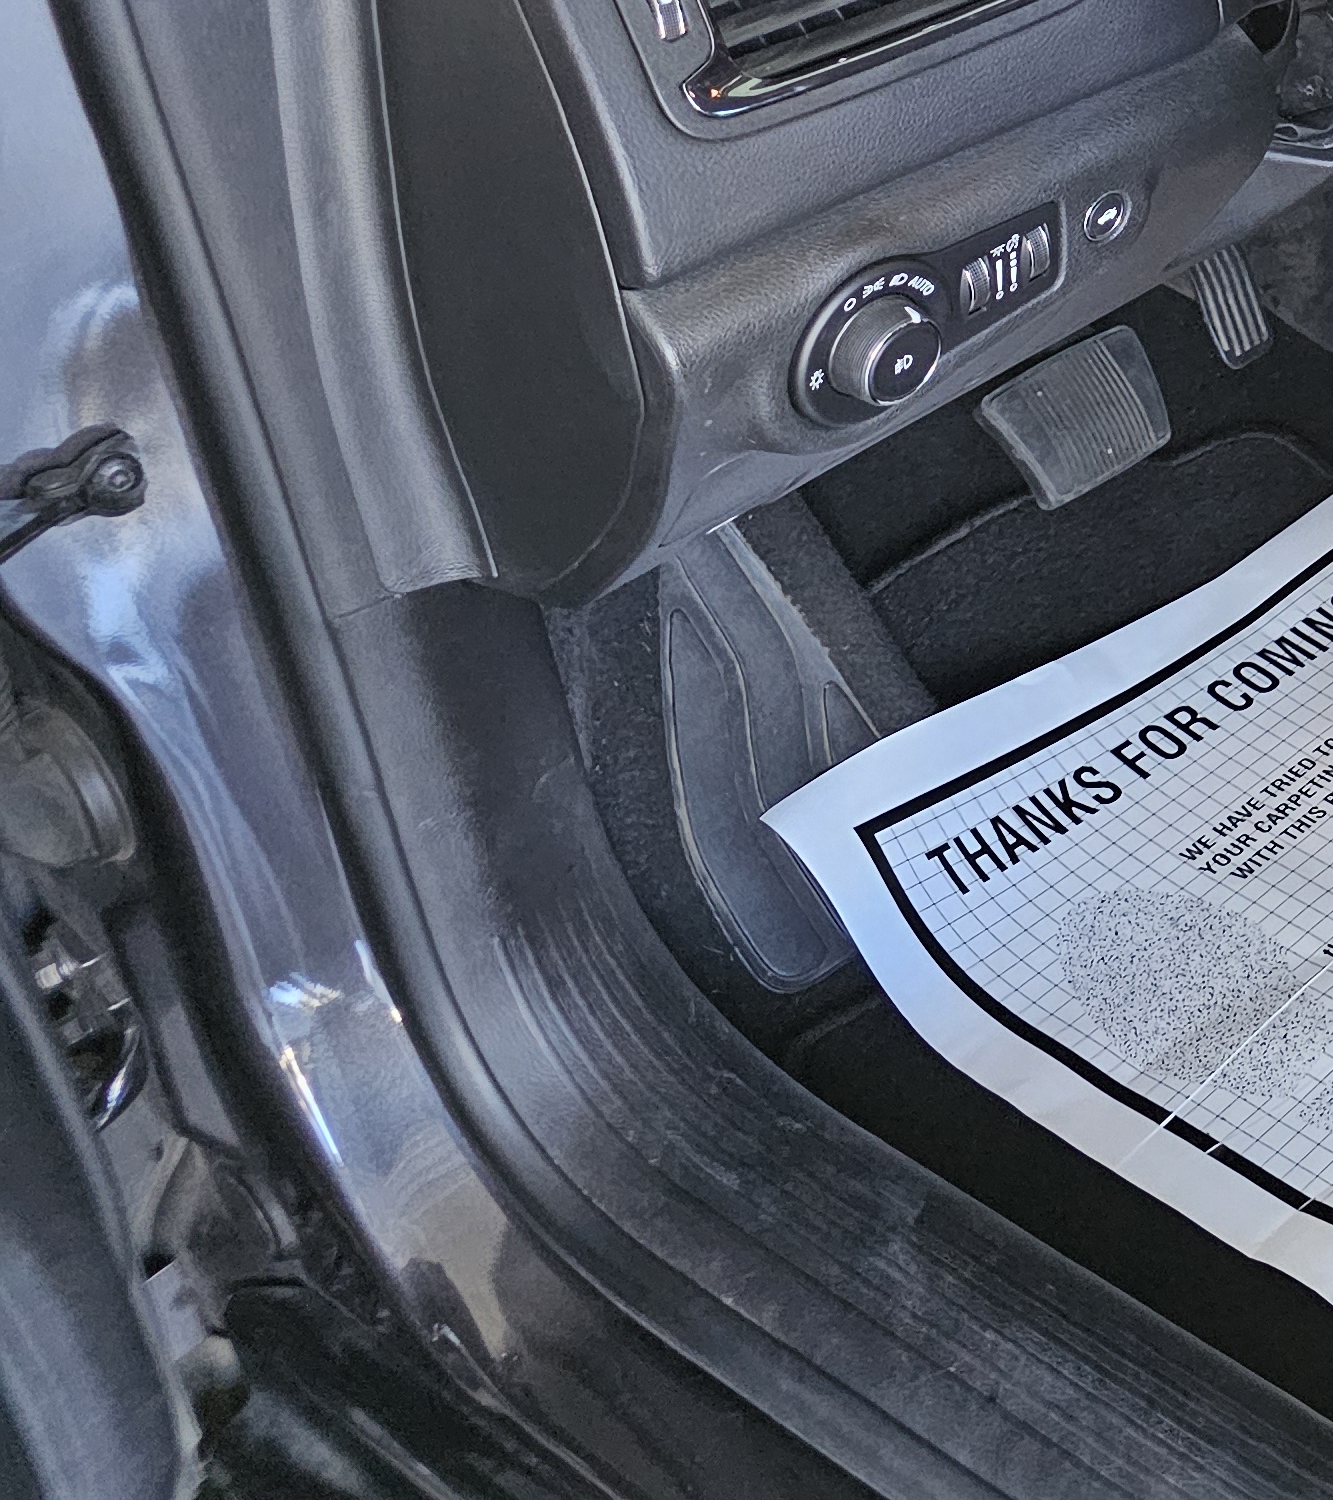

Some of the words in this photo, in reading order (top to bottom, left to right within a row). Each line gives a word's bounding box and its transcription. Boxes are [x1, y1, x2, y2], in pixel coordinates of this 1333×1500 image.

[907, 275, 935, 296] AUTO
[925, 766, 1123, 895] THANKS
[1110, 705, 1221, 780] FOR
[1179, 835, 1217, 862] WE
[1212, 797, 1266, 837] HAVE
[1260, 757, 1317, 798] TRIED
[1199, 833, 1258, 875] YOUR
[1229, 840, 1285, 880] WITH
[1280, 806, 1327, 840] THIS
